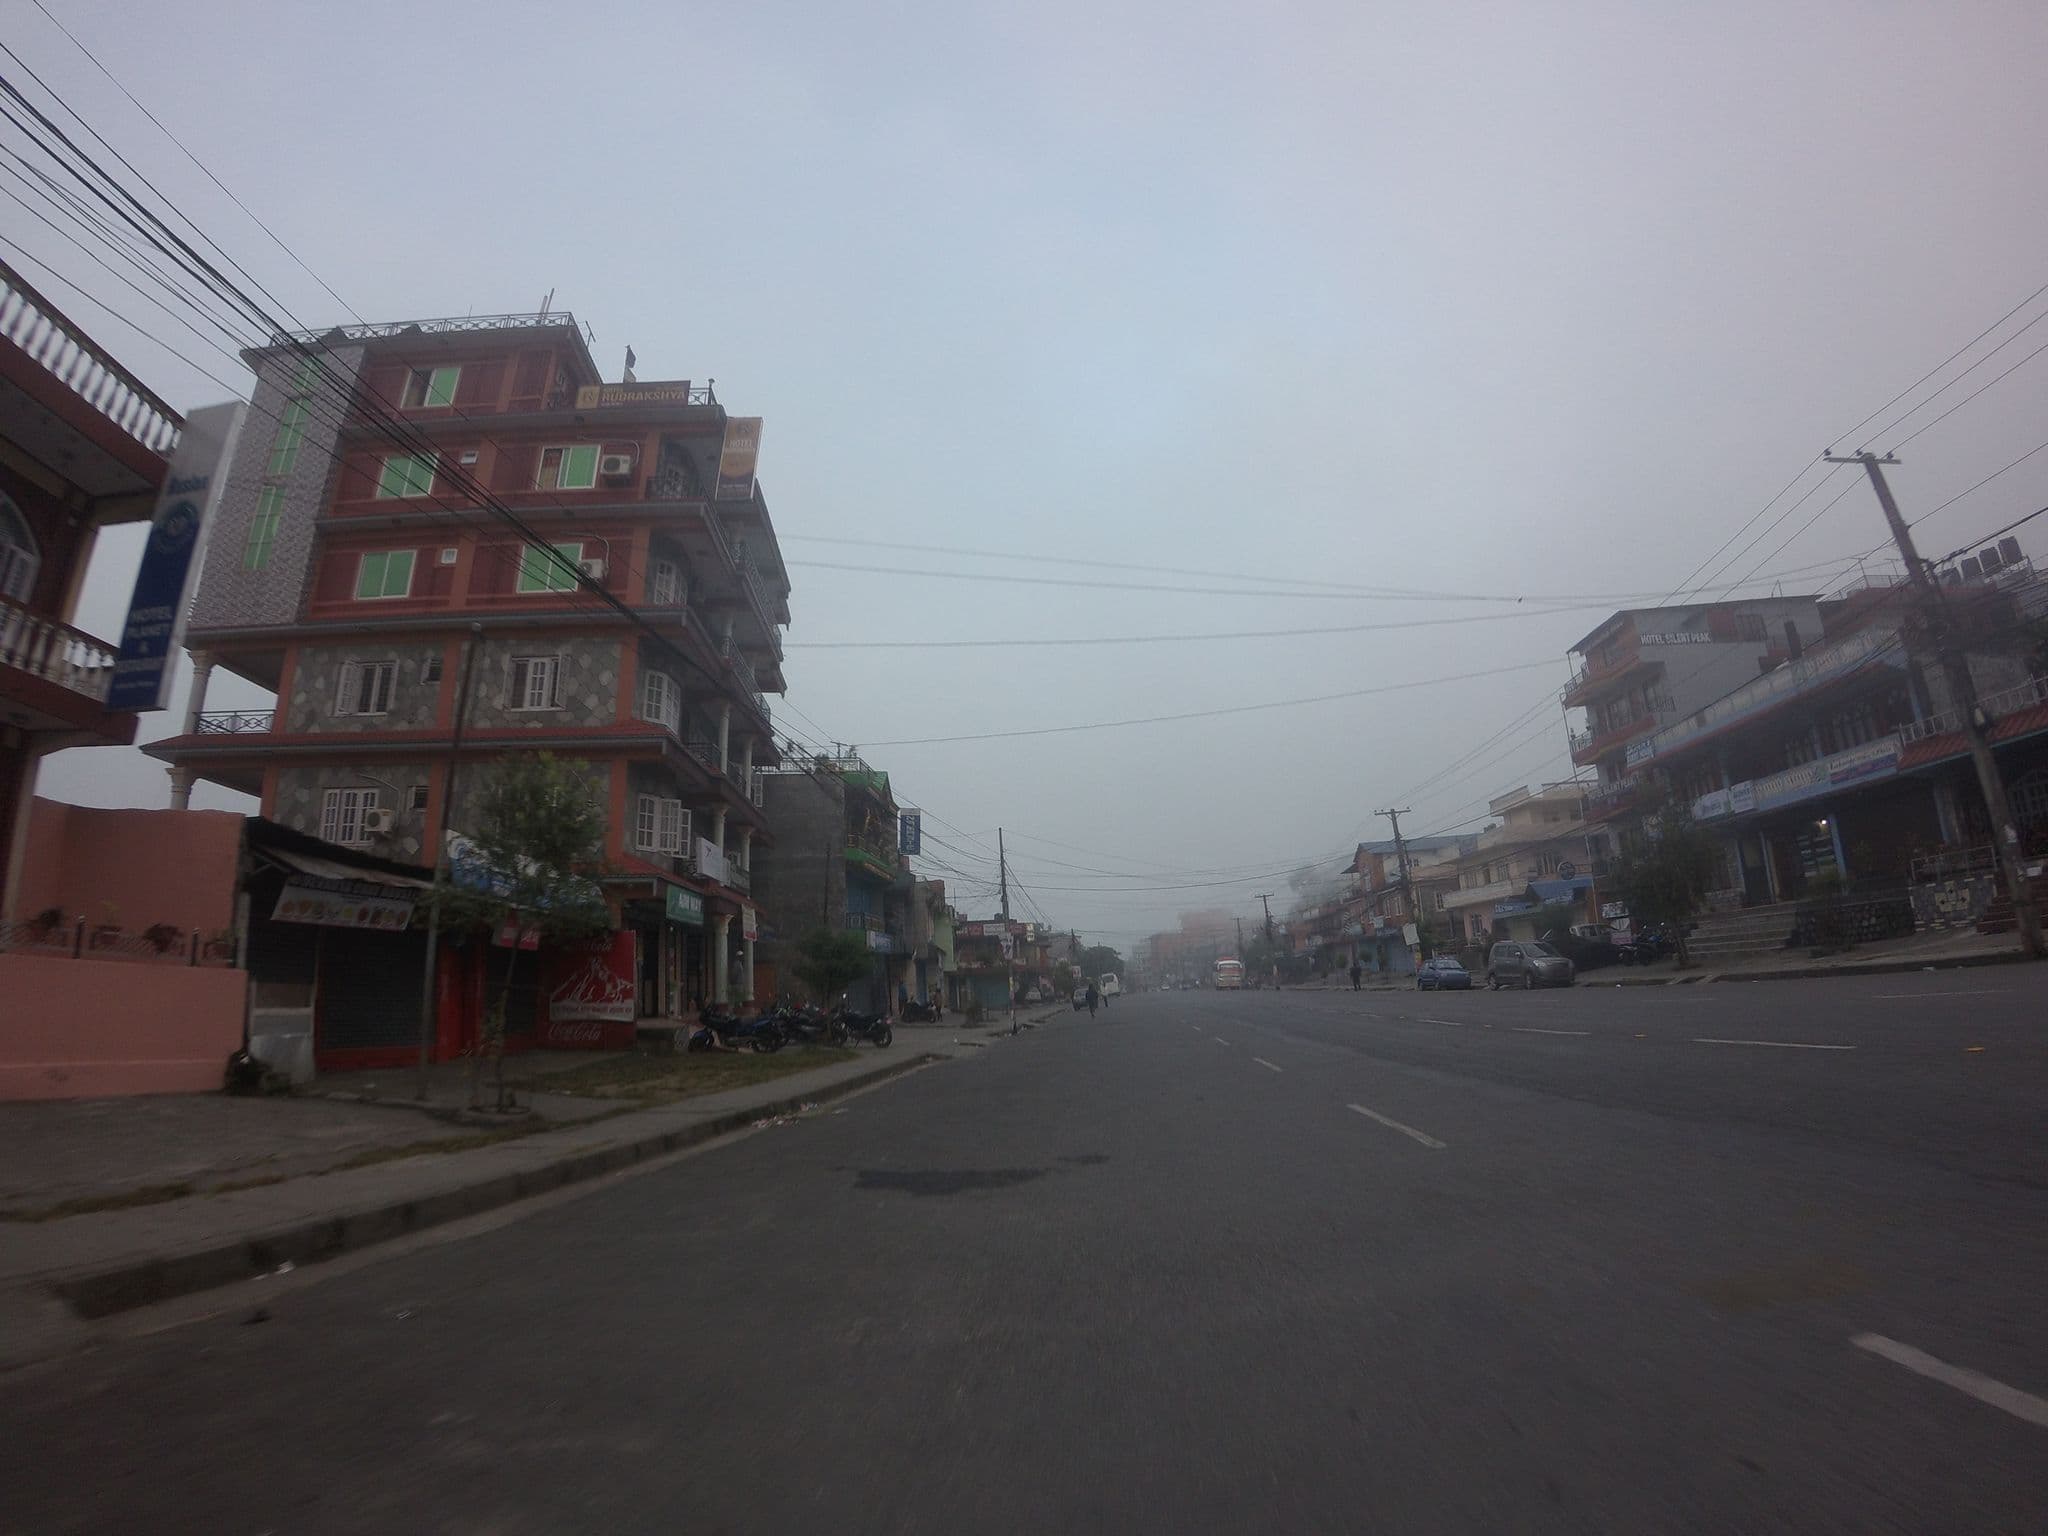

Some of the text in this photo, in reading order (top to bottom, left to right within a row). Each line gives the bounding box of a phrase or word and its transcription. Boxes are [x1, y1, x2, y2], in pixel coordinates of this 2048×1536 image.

[601, 390, 686, 402] RUDRAKSHYA
[1640, 631, 1712, 645] HOTEL SILENT PEAK
